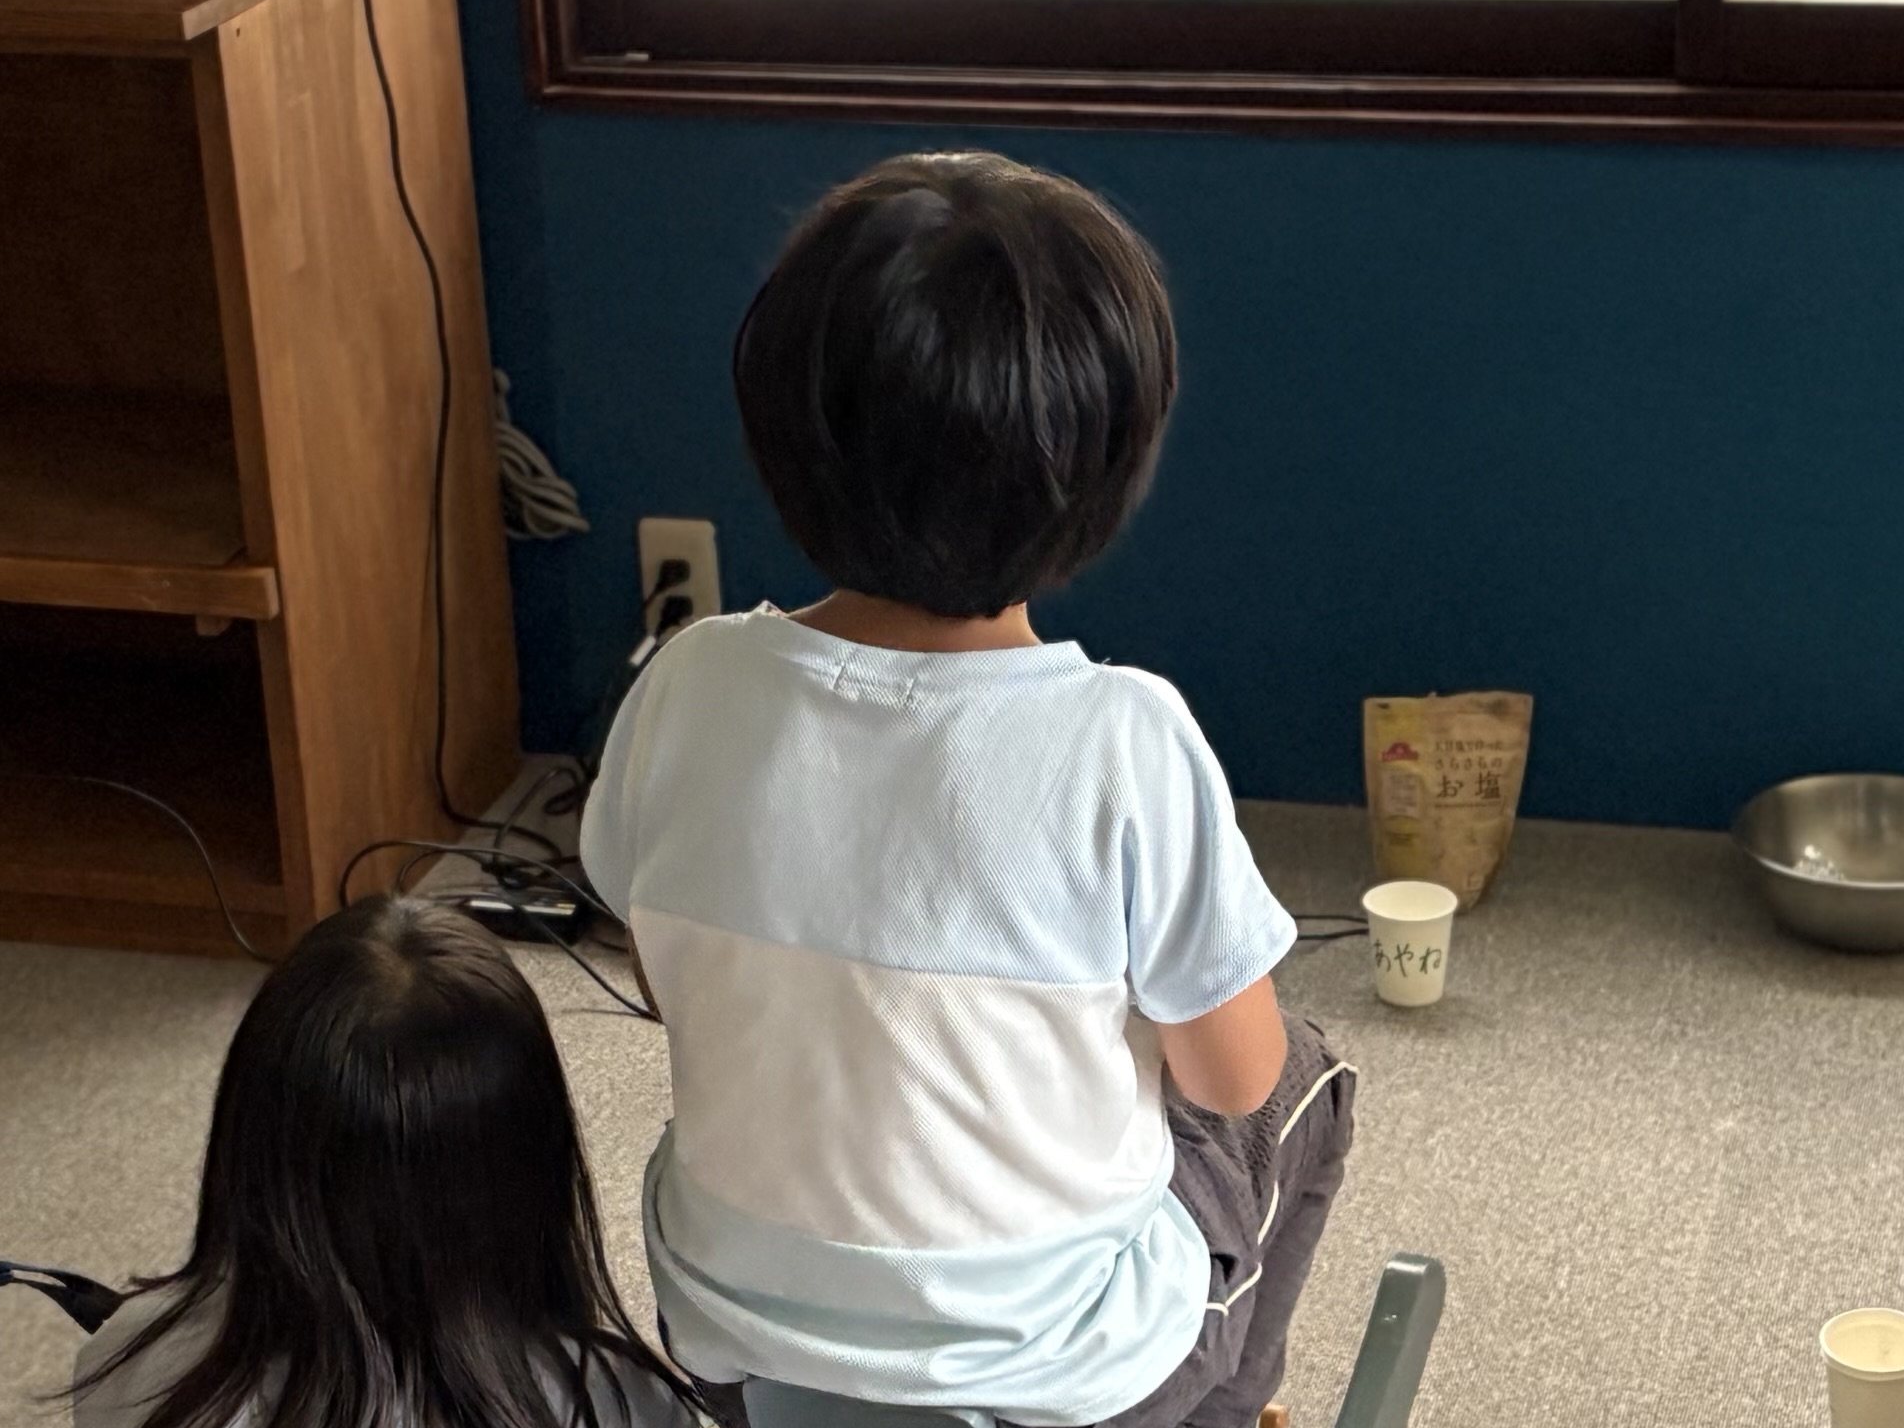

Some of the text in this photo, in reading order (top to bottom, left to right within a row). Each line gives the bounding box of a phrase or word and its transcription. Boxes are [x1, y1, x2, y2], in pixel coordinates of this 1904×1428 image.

[1436, 771, 1501, 800] お塩
[1374, 938, 1442, 978] あやね
